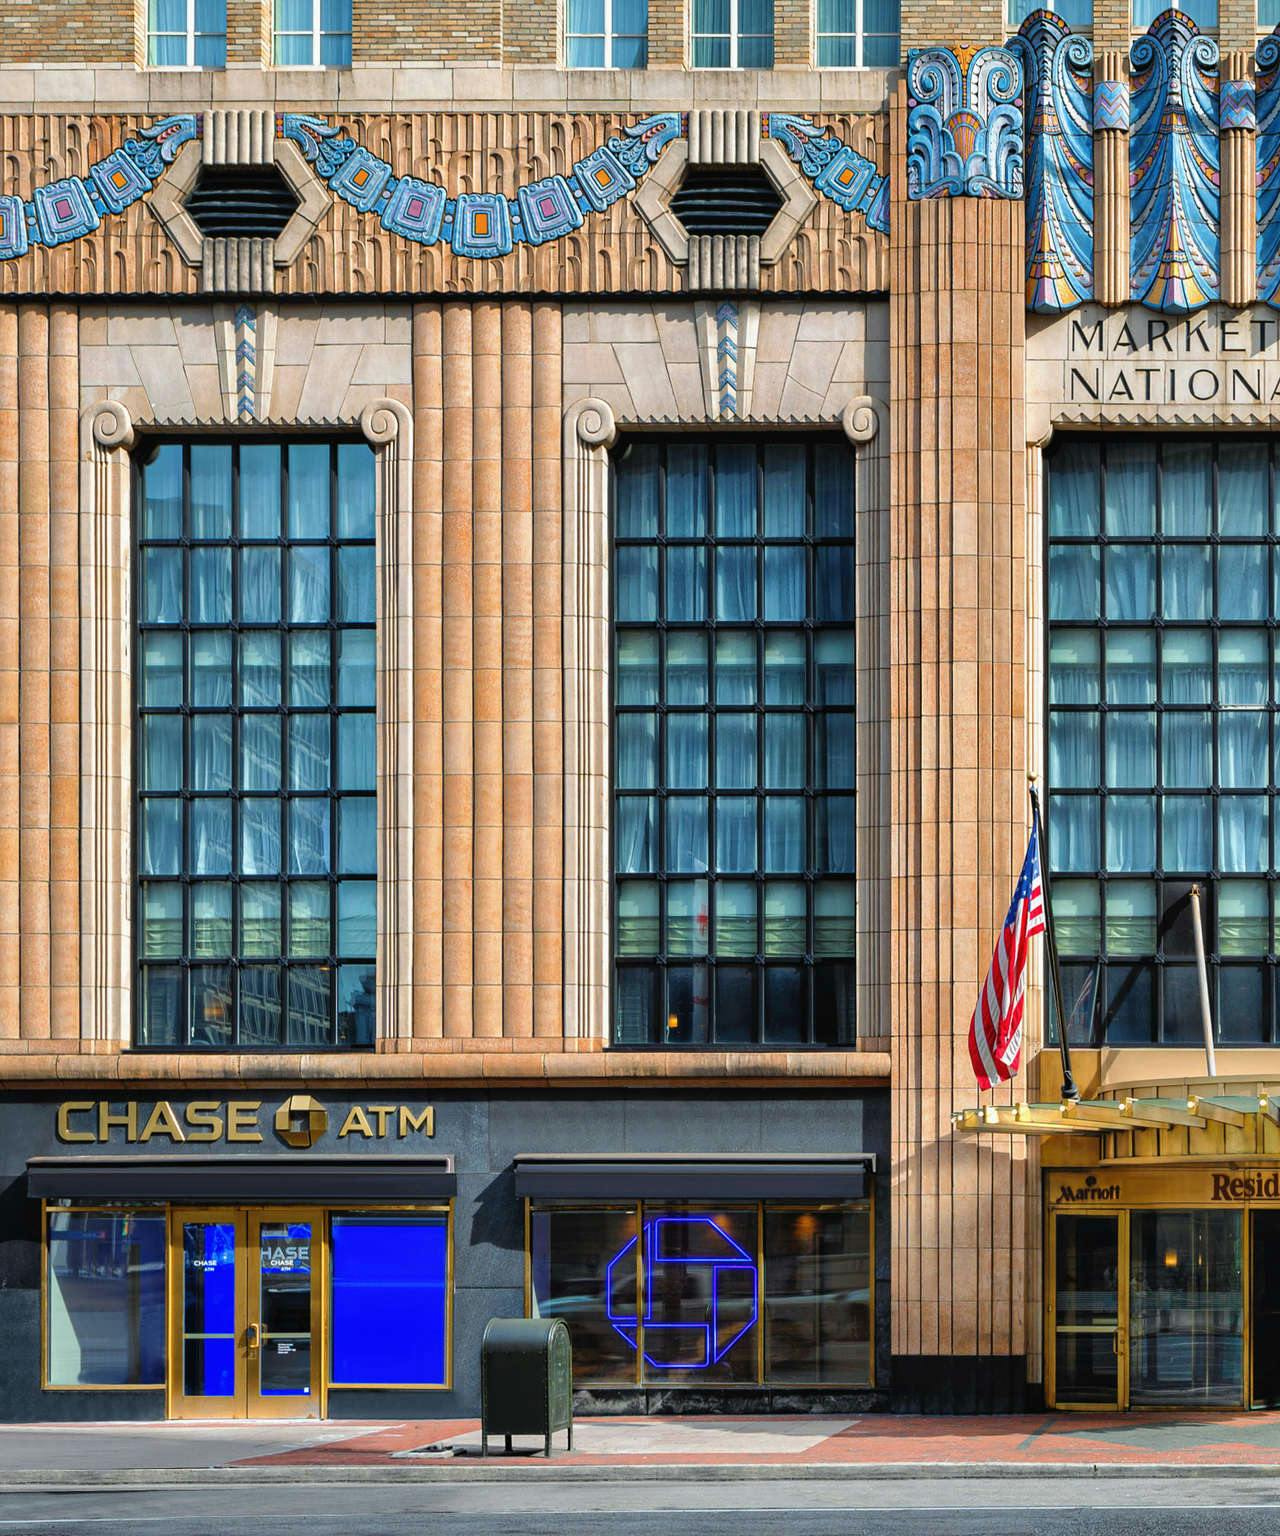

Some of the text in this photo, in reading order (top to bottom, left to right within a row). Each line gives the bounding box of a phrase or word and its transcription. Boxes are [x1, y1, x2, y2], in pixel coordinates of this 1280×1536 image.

[1070, 319, 1277, 353] MARKET
[57, 1100, 435, 1143] CHASE ATM
[261, 1246, 309, 1260] HASE
